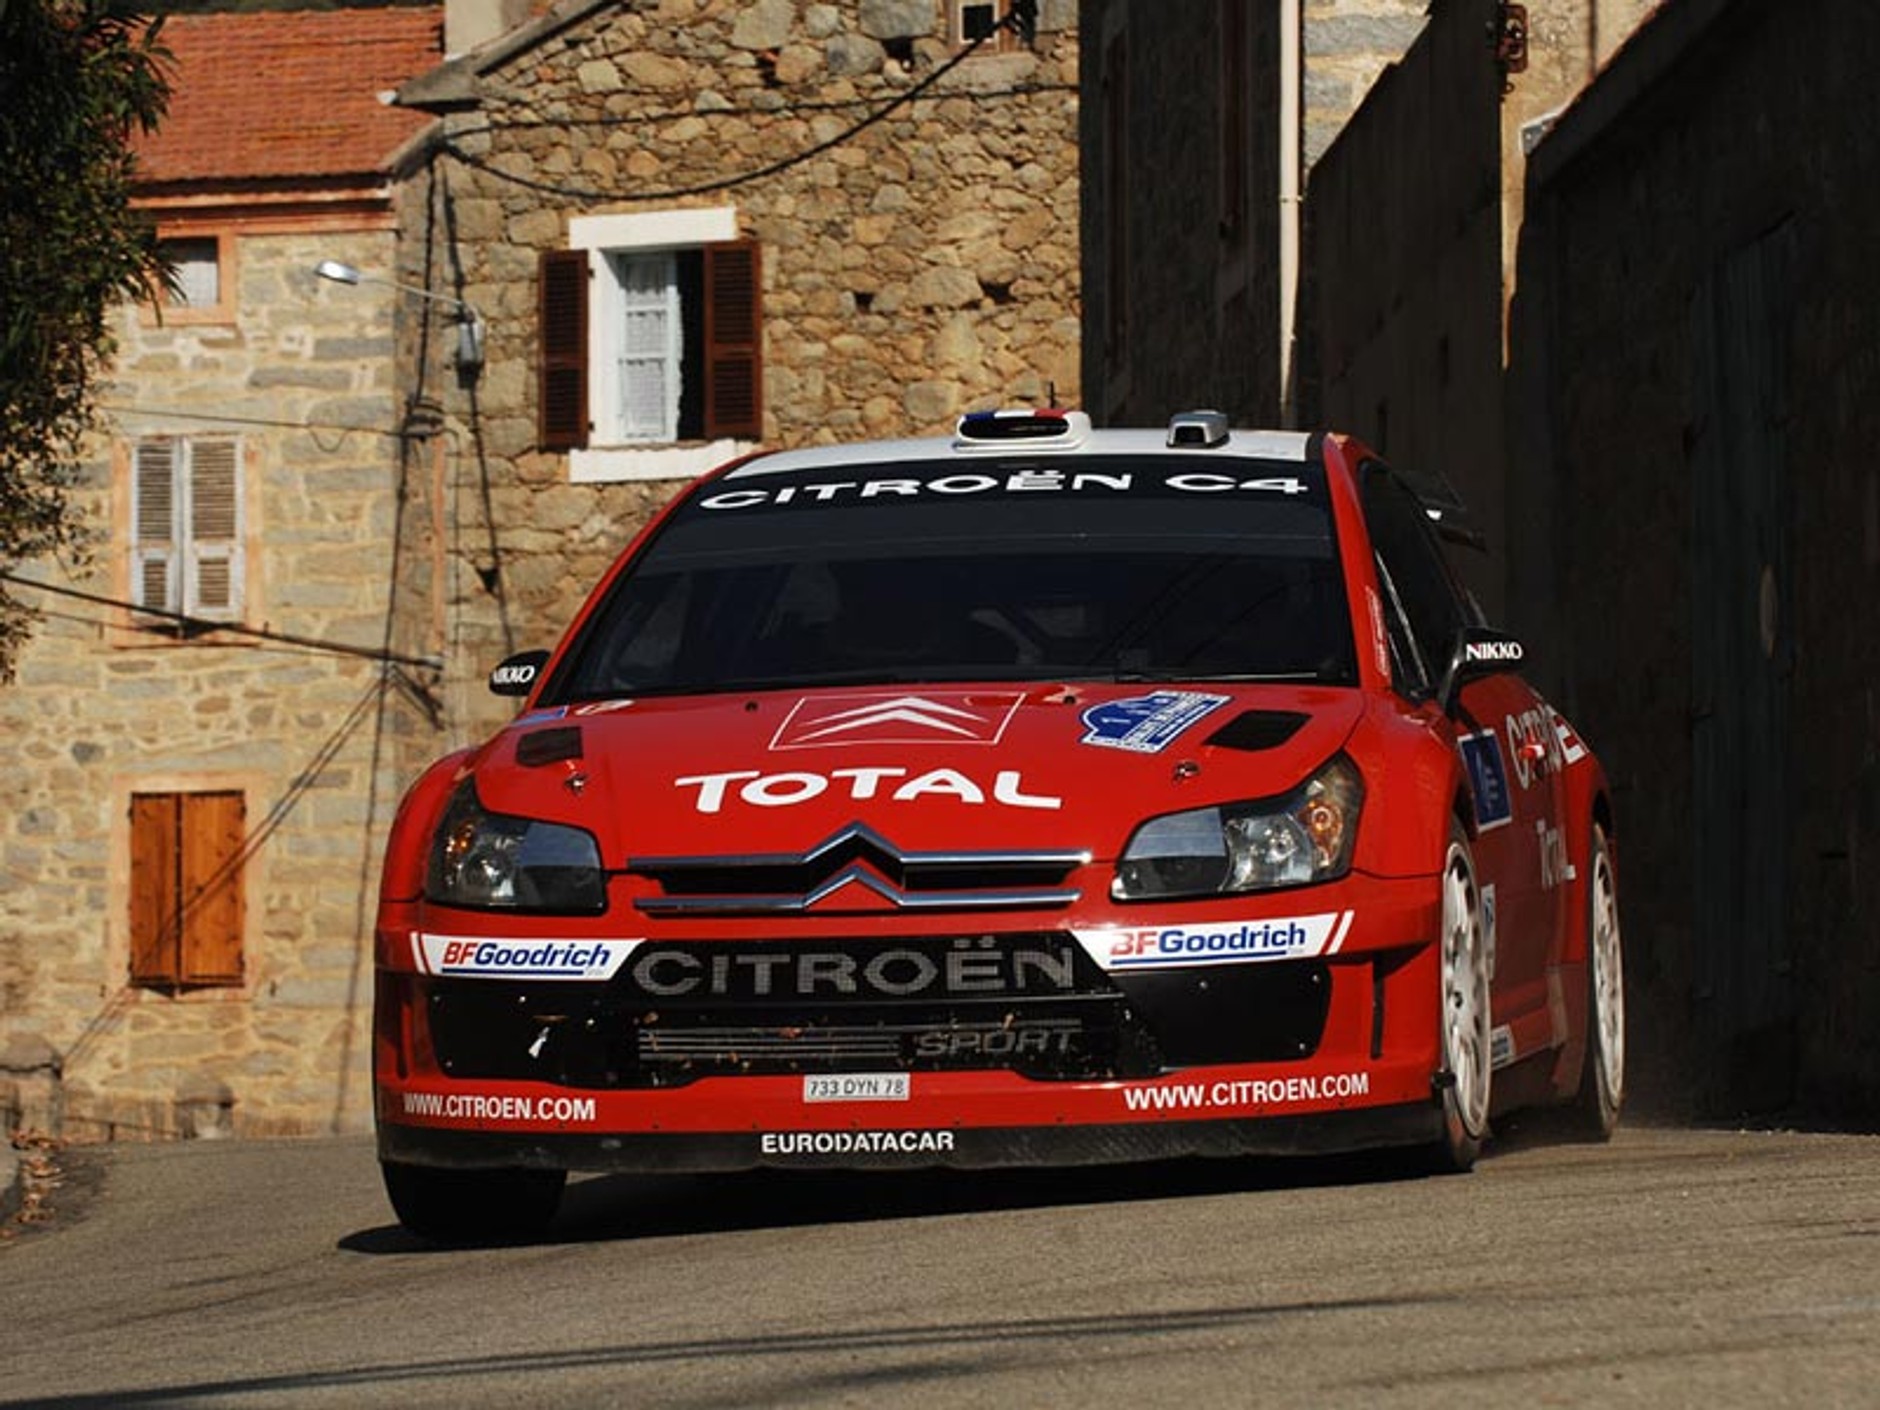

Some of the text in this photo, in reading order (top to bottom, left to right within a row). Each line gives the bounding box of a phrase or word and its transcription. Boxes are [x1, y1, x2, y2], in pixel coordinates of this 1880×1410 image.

[700, 470, 1308, 509] CITROËN C4
[1465, 641, 1523, 661] NIKKO
[674, 767, 1062, 813] TOTAL
[1109, 922, 1306, 956] BFGoodrich
[443, 942, 611, 967] BFGoodrich
[632, 936, 1074, 996] CITROËN
[916, 1029, 1081, 1056] SPORT
[810, 1079, 905, 1096] 733 DYN 78
[1123, 1072, 1370, 1111] WWW.CITROEN.COM
[403, 1093, 597, 1122] WWW.CITROEN.COM
[761, 1131, 955, 1153] EURODATACAR
